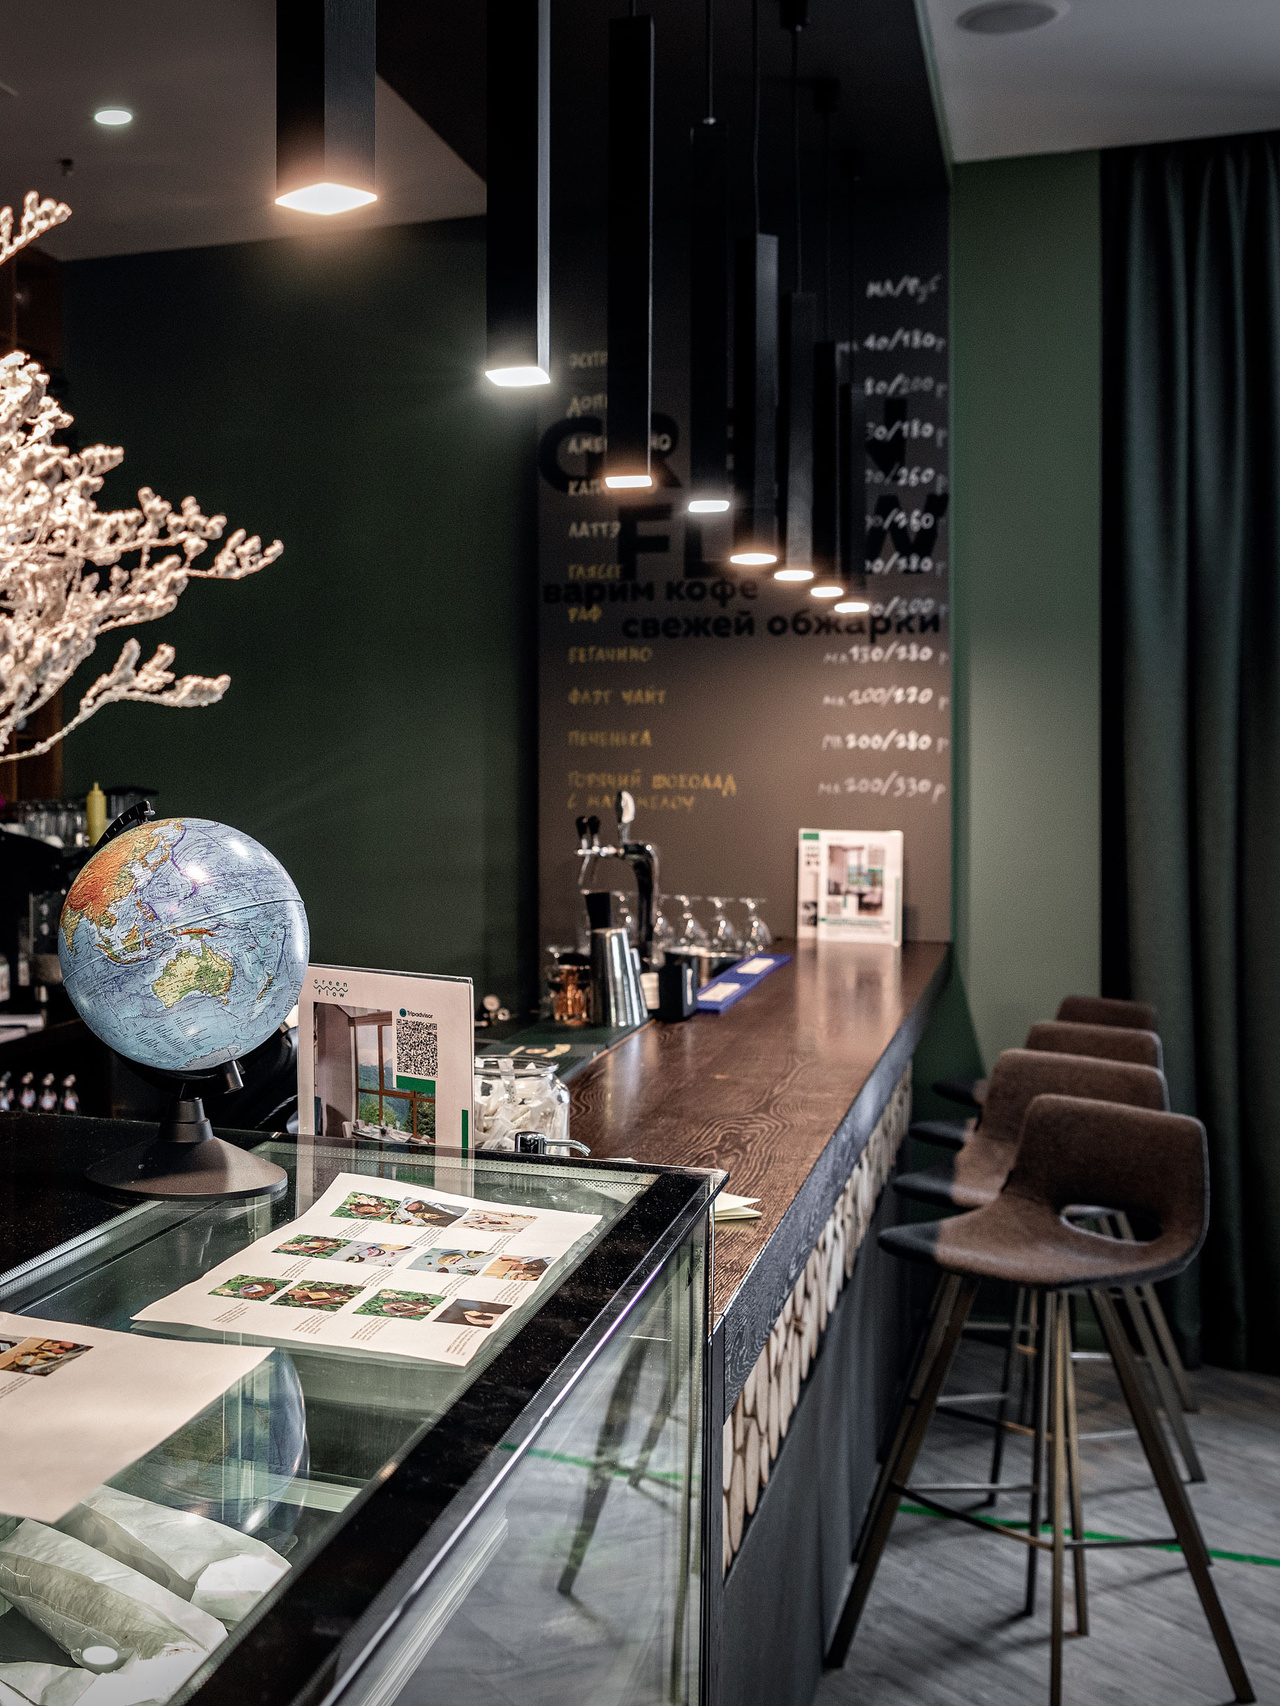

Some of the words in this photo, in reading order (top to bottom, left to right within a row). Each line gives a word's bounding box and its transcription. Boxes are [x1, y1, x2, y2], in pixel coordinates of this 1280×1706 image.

[542, 579, 655, 610] варим
[665, 577, 759, 609] кофе
[622, 610, 755, 640] свежей
[767, 609, 941, 643] обжарки
[406, 1009, 434, 1019] Tripadvisor
